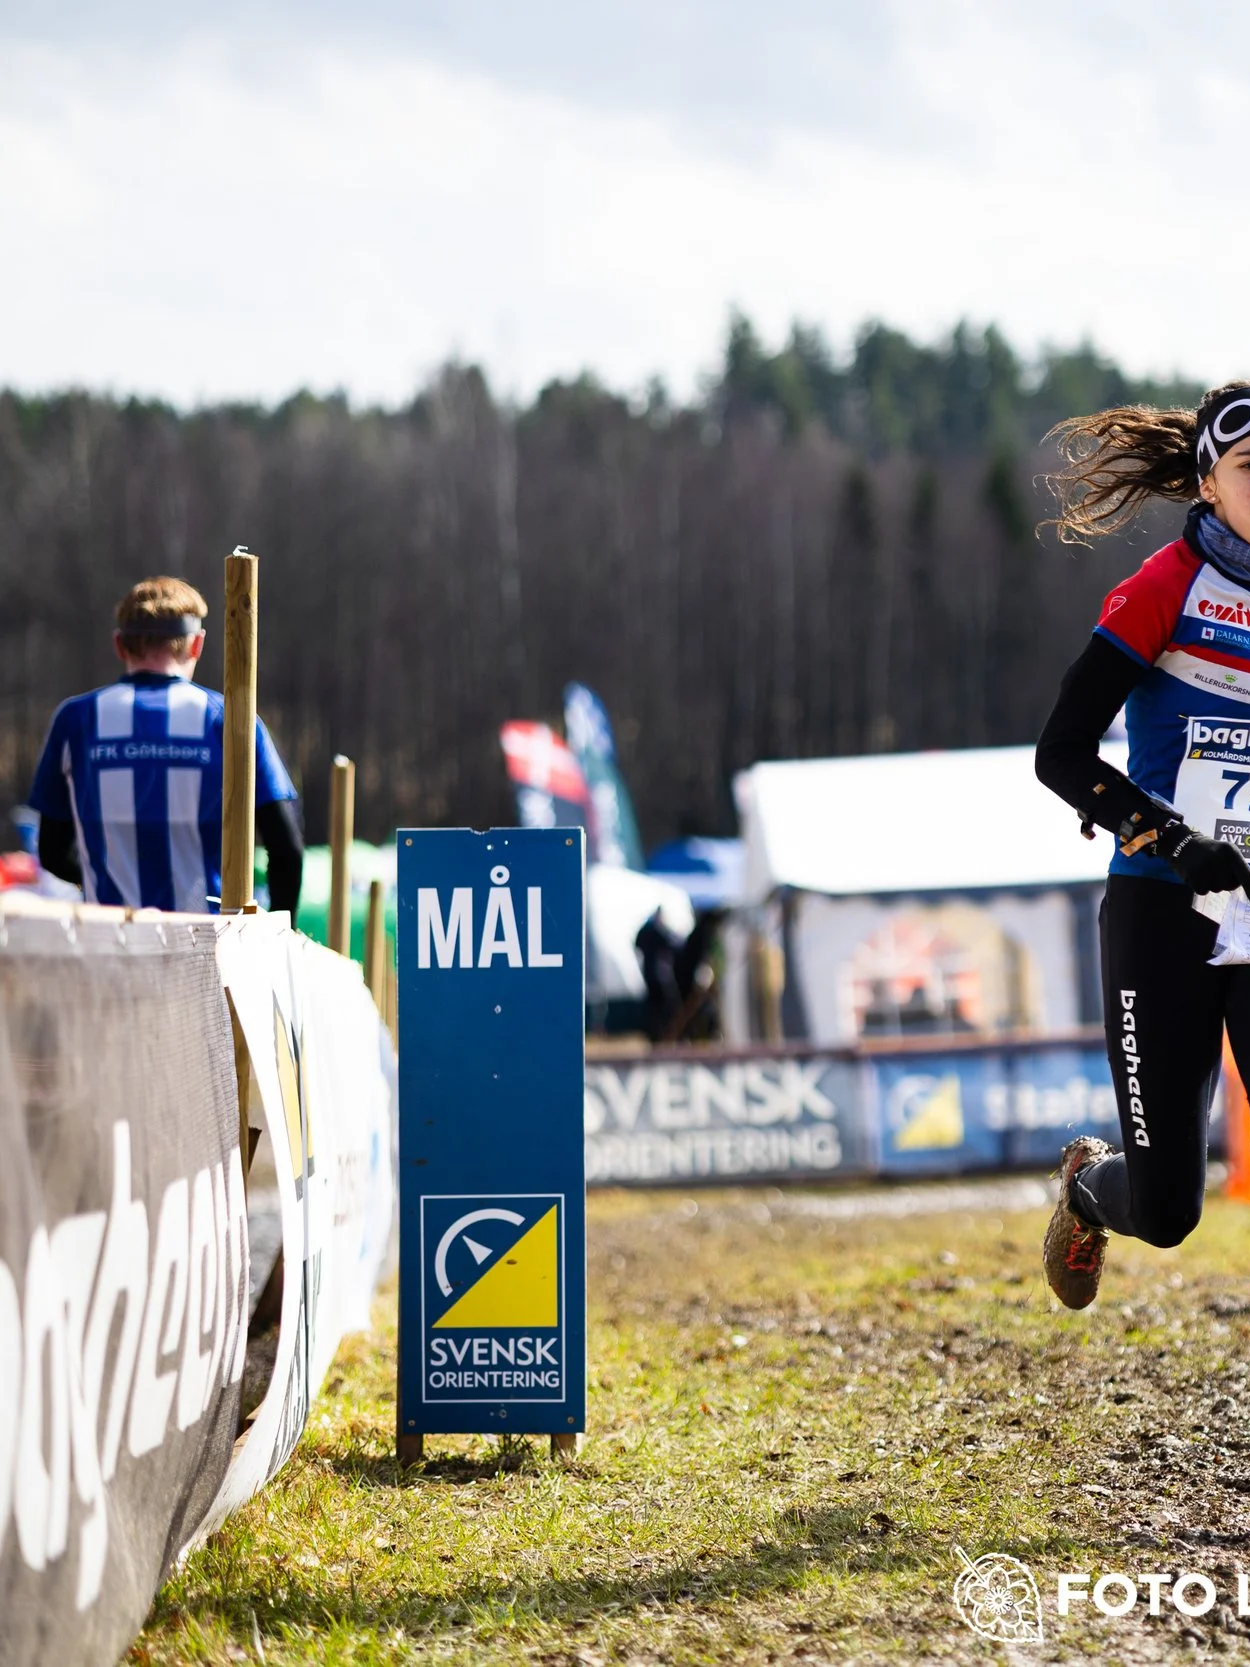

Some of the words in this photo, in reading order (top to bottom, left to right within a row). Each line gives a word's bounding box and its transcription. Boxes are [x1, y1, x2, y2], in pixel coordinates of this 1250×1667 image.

[90, 743, 118, 760] IFK
[124, 742, 211, 764] Göteborg
[1172, 834, 1193, 858] KIPRUN
[418, 865, 563, 968] MÅL
[1120, 990, 1150, 1148] bagheera
[430, 1337, 559, 1366] SVENSK
[429, 1371, 560, 1388] ORIENTERING
